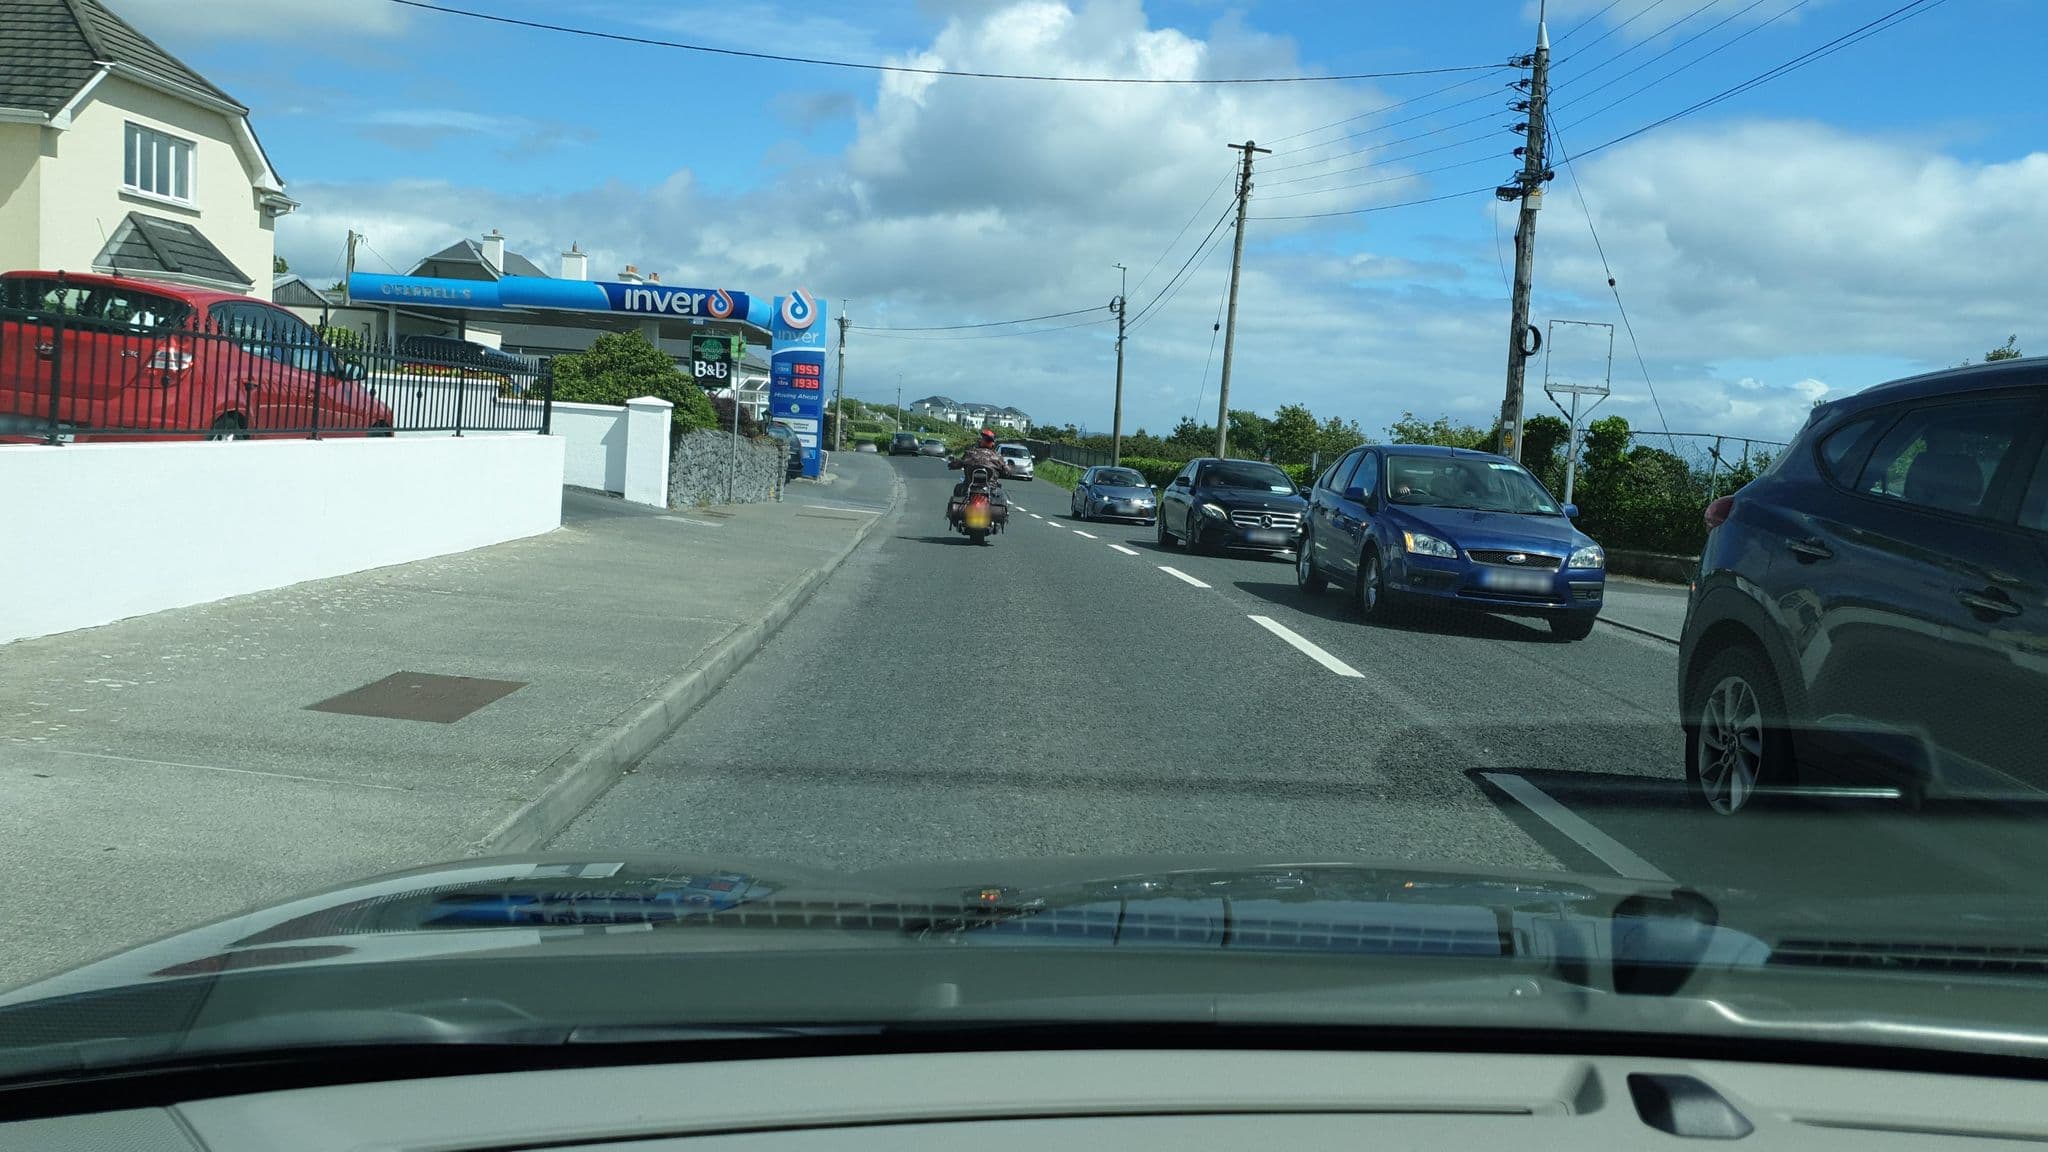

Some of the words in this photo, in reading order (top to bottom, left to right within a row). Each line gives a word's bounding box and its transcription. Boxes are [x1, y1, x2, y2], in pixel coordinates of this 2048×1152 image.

[381, 283, 471, 299] O'FARRELL'S
[625, 288, 706, 315] inver
[777, 330, 819, 344] inver
[694, 361, 728, 379] B&B
